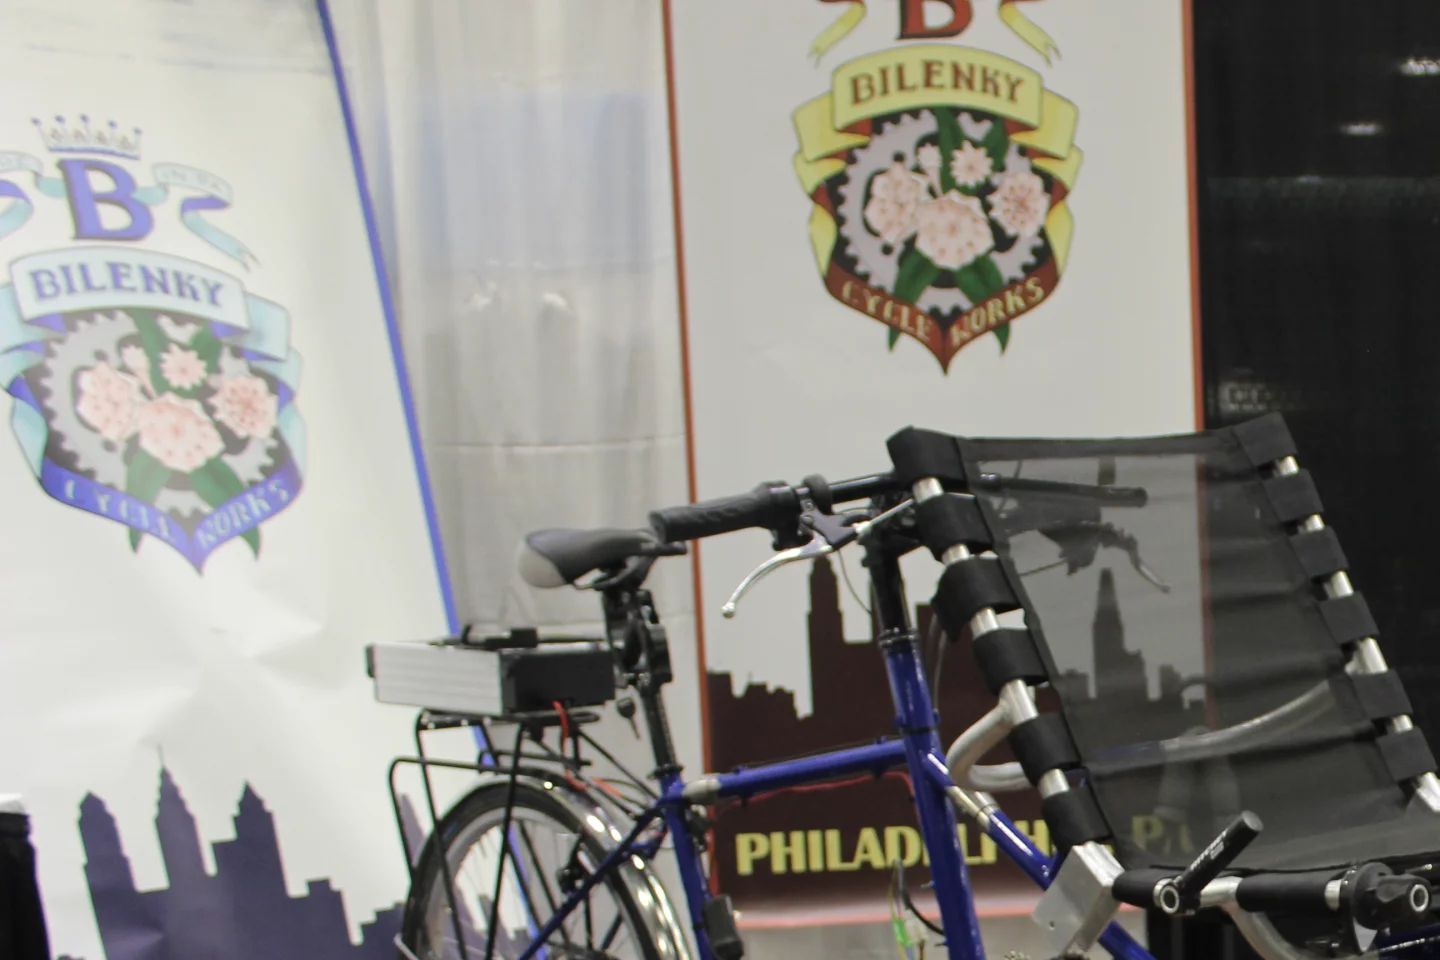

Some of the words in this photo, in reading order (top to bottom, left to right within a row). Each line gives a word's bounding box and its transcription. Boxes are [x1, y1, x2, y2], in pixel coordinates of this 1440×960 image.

[850, 59, 1024, 105] BILENKY
[57, 158, 154, 241] B
[29, 261, 223, 307] BILENKY
[951, 277, 1045, 346] WORKS
